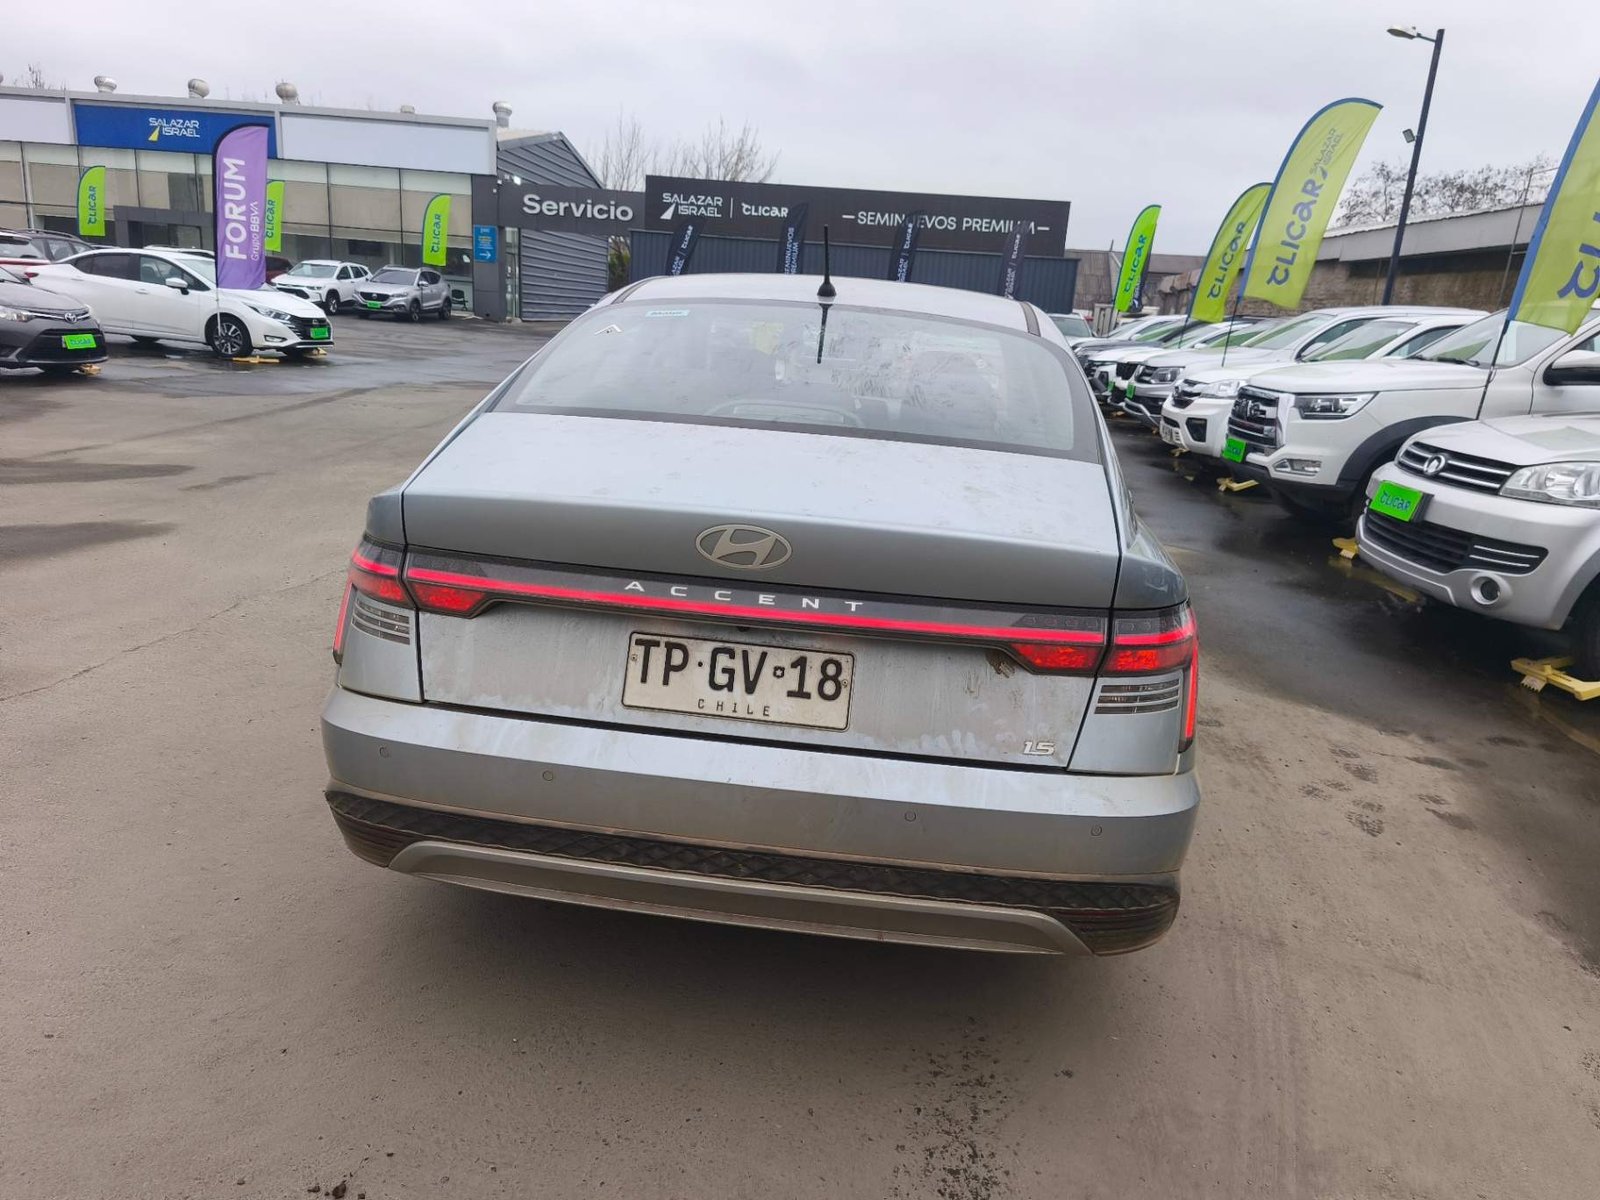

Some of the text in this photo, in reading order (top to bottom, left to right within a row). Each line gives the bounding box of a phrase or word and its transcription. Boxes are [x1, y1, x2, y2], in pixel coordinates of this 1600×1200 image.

[149, 117, 200, 129] SALAZAR
[162, 127, 201, 138] ISRAEL
[223, 157, 248, 260] FORUM
[522, 193, 634, 222] Servicio
[662, 192, 723, 207] SALAZAR
[678, 205, 722, 218] ISRAEL
[250, 201, 260, 261] Grupo BBVA
[857, 210, 957, 231] SEMINEVOS
[785, 227, 794, 275] EMINUEVOS
[790, 242, 799, 274] REMIUM
[624, 581, 863, 612] ACCENT
[697, 698, 771, 718] CHILE
